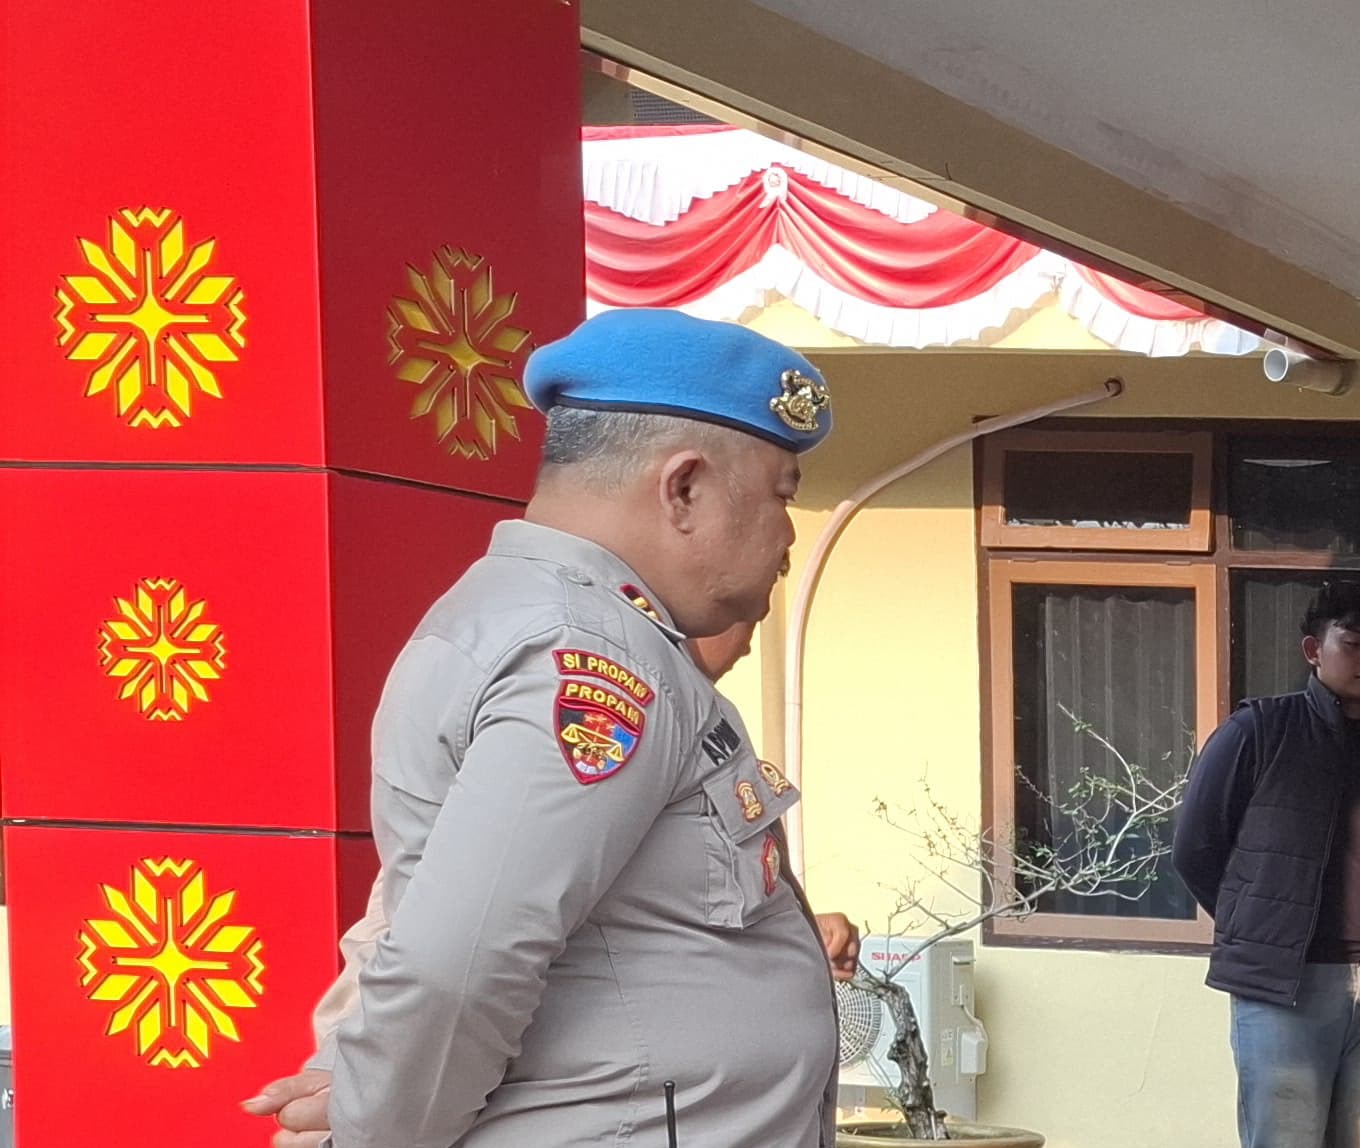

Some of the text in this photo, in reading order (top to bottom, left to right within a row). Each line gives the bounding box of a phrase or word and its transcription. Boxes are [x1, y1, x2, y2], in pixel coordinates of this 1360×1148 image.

[562, 653, 648, 699] SI PROPAM
[565, 683, 641, 725] PROPAM
